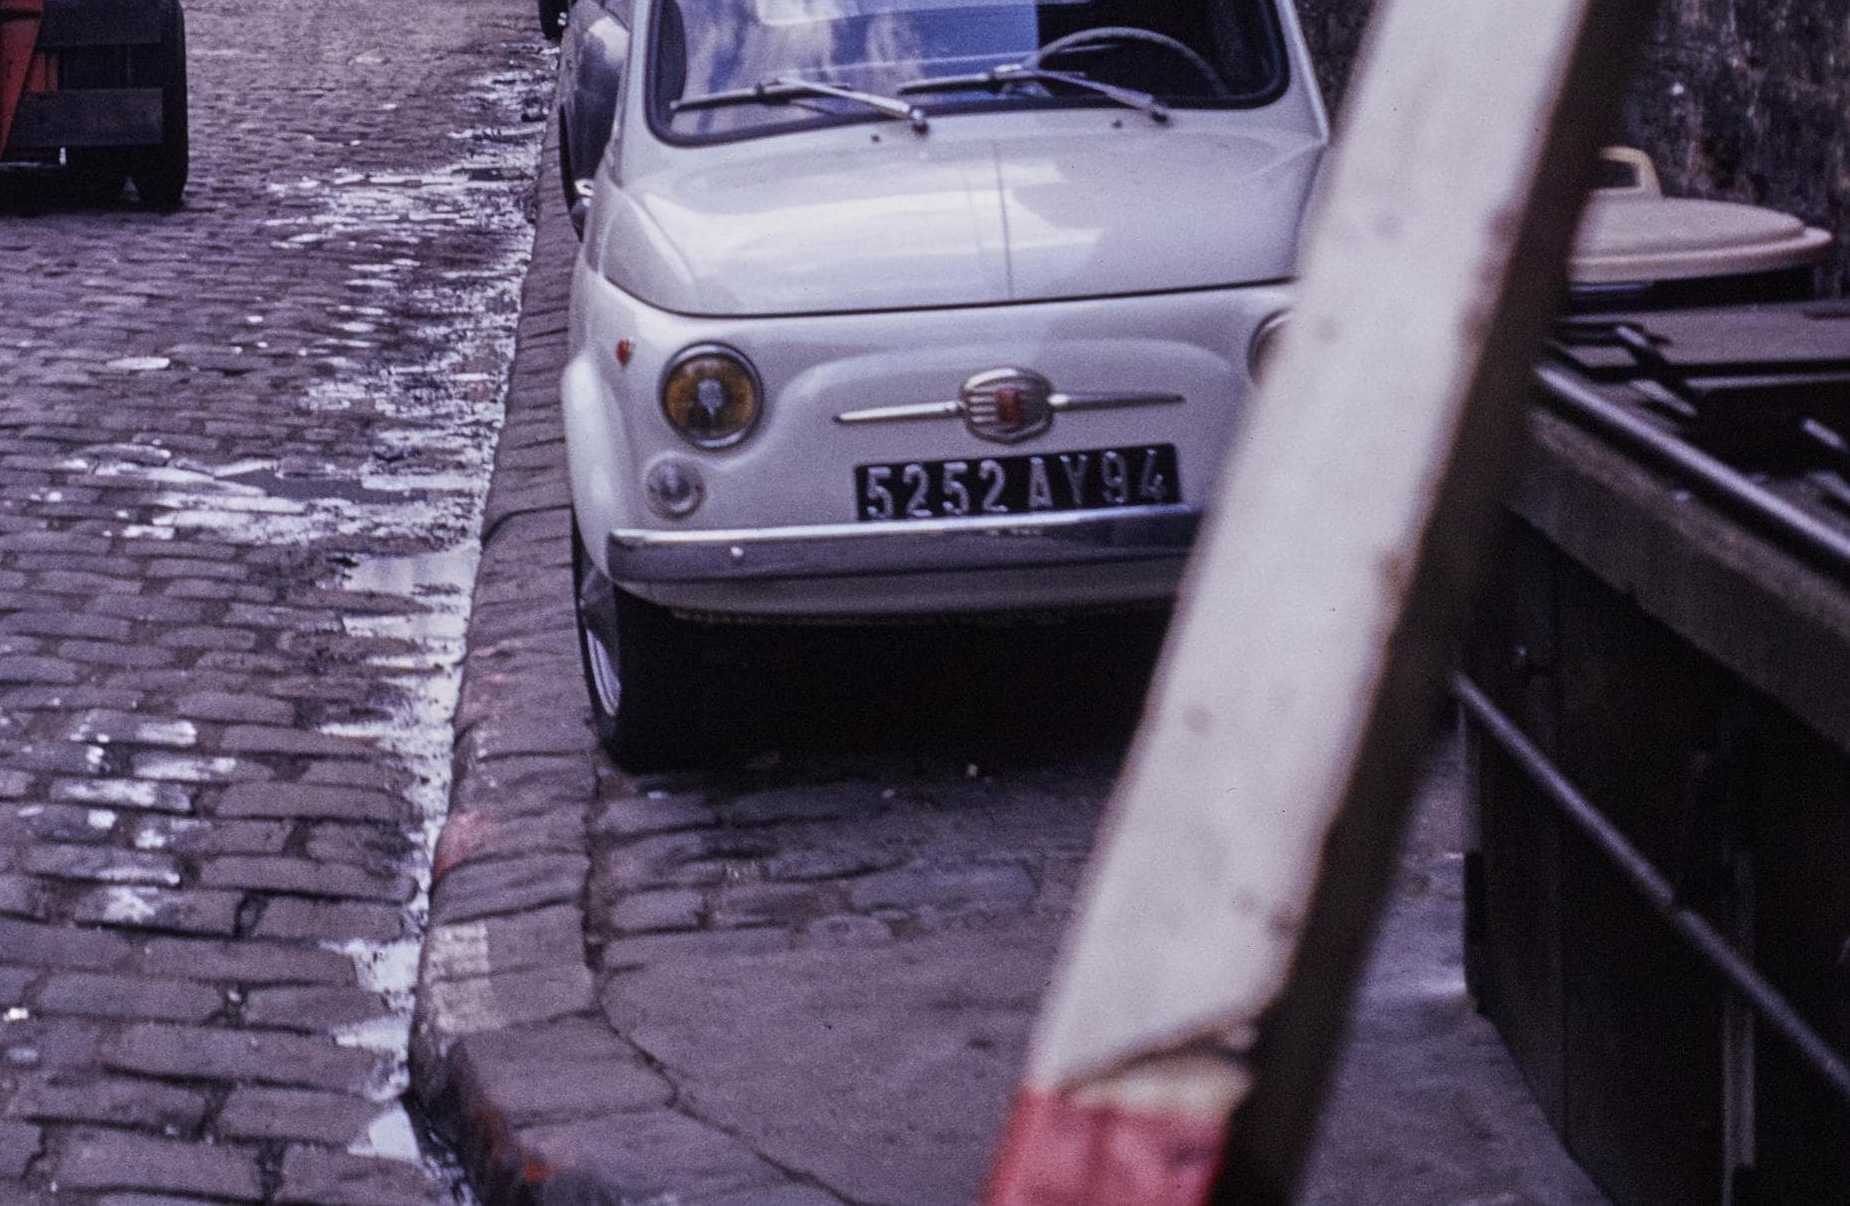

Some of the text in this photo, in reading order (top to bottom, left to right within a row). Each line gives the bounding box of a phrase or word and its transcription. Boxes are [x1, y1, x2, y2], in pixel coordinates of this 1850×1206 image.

[867, 448, 1167, 520] 5252 AY 94
